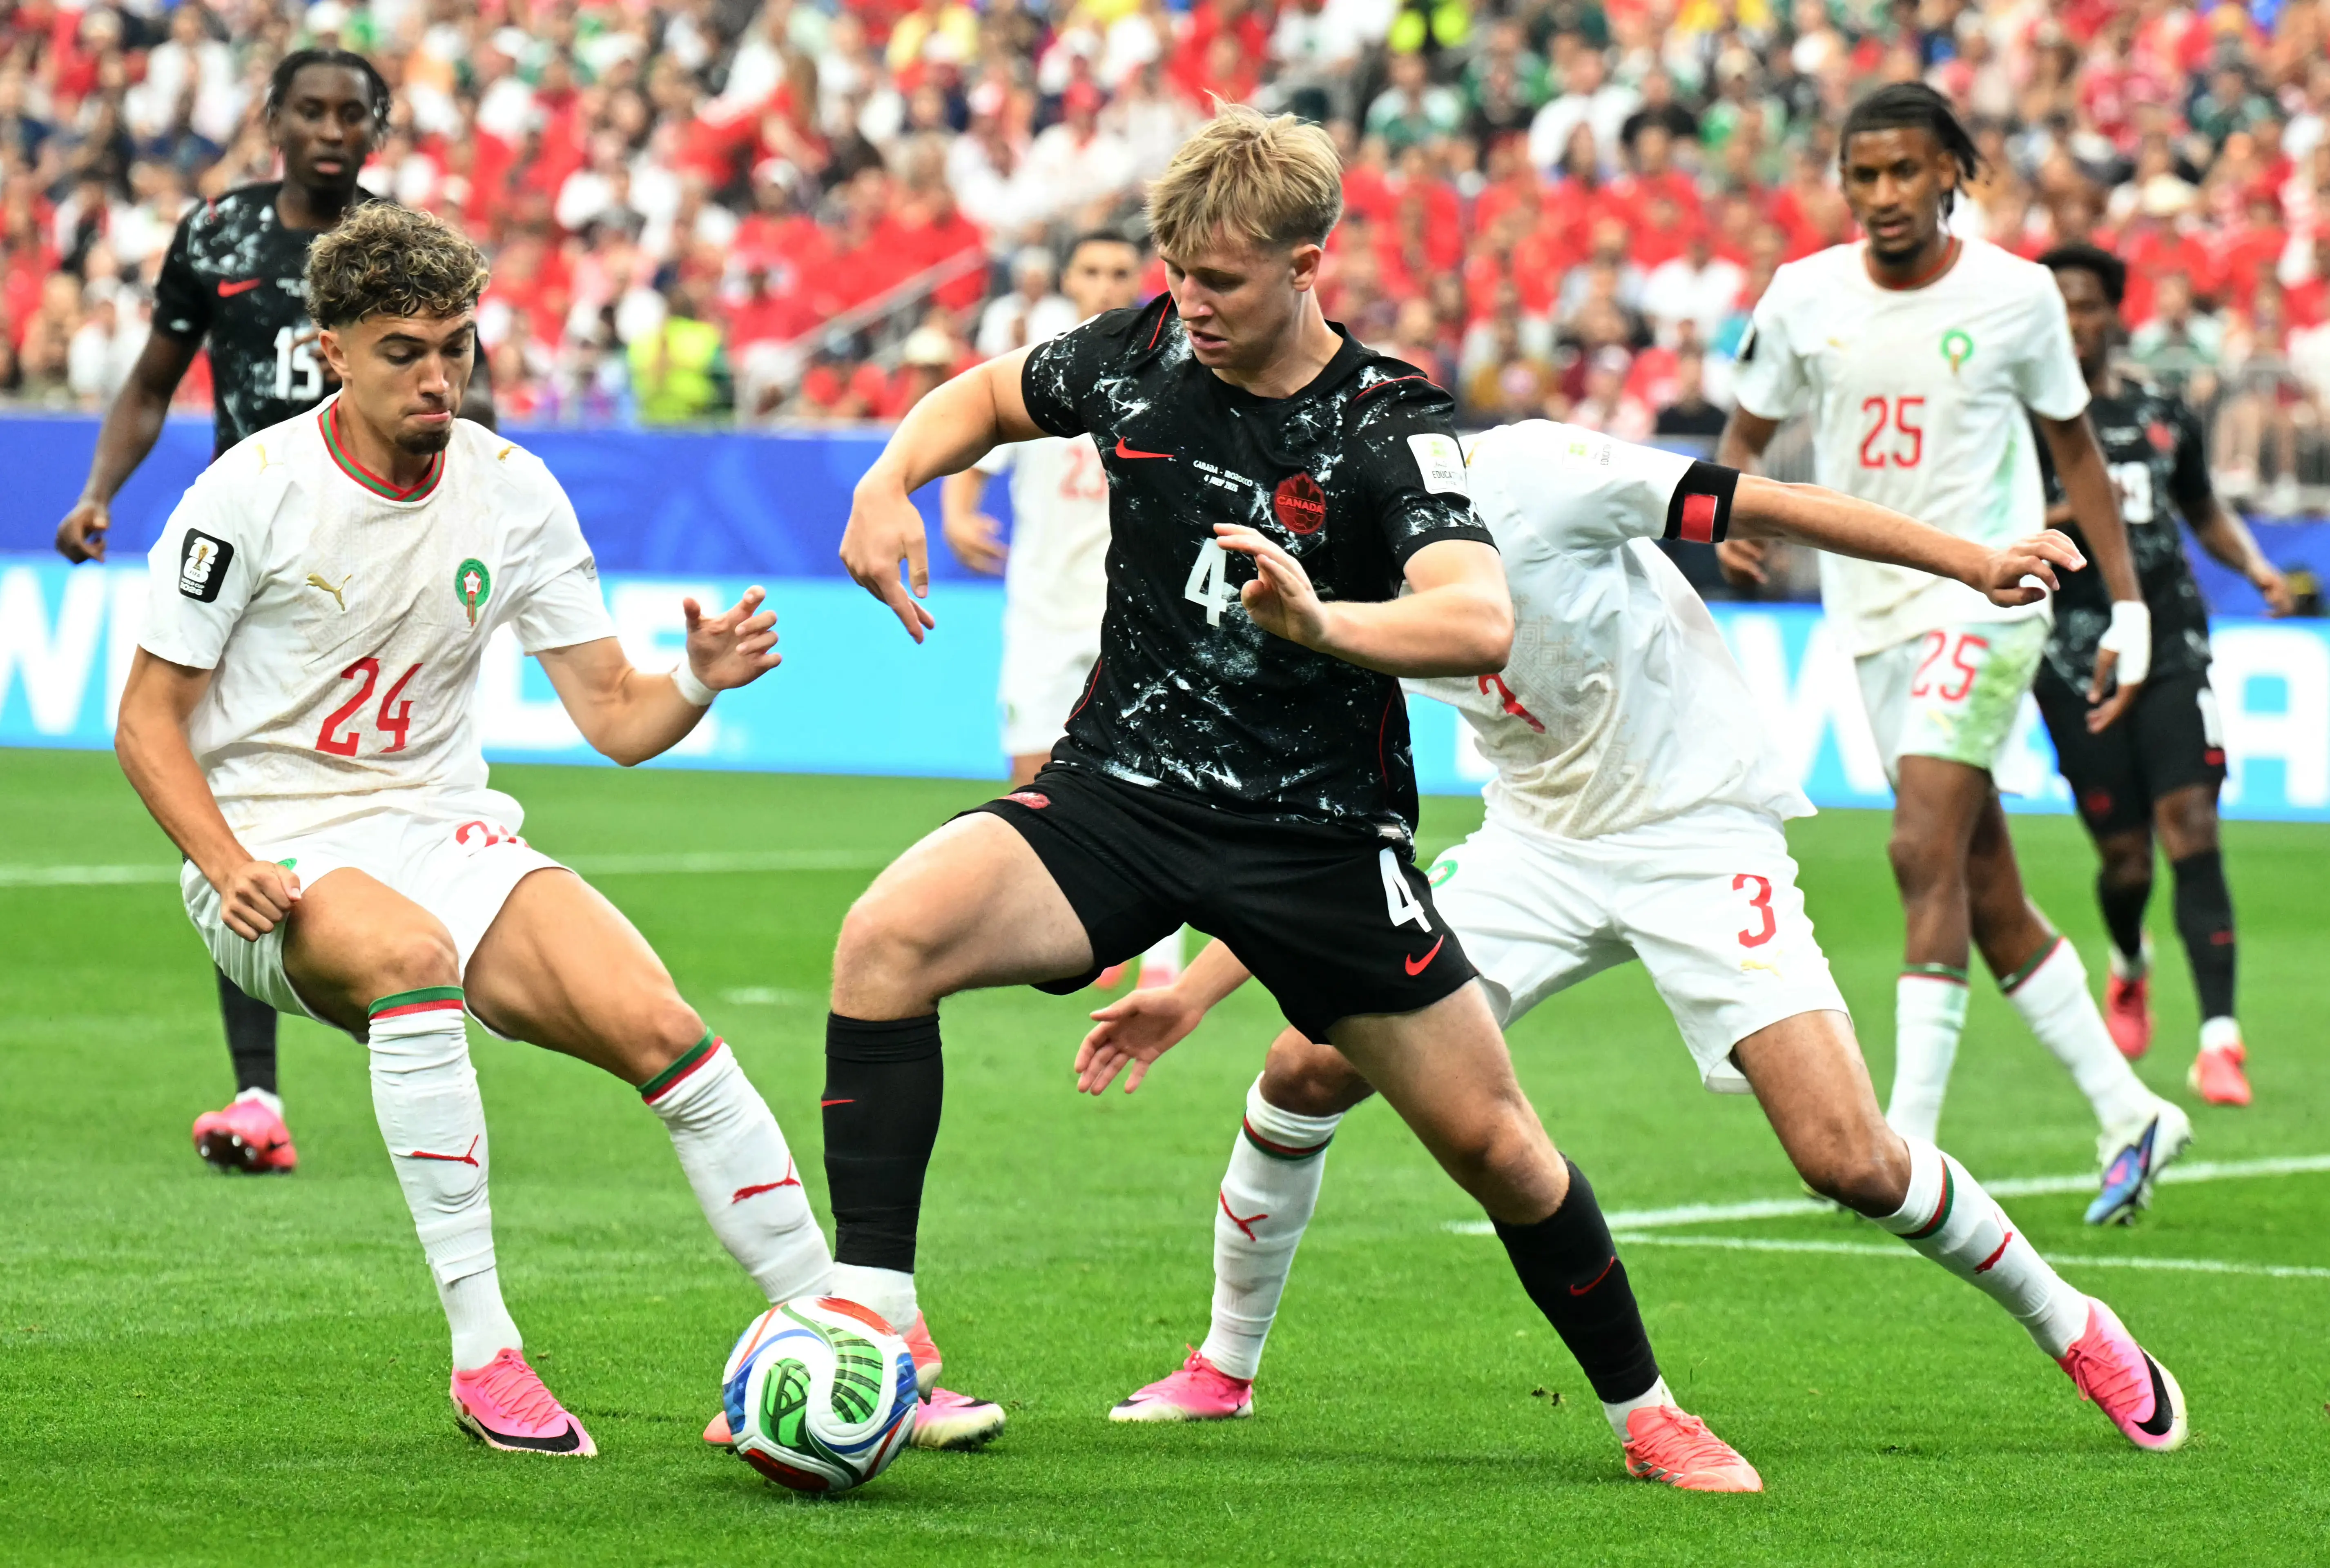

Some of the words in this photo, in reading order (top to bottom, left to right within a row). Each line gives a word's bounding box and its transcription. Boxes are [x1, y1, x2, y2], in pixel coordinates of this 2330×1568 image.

[274, 326, 323, 401] 15
[1860, 395, 1926, 469] 25
[1193, 460, 1218, 474] CANADA
[1224, 470, 1253, 487] MOROCCO
[1209, 476, 1225, 487] JULY
[1224, 481, 1239, 492] 2026
[1277, 496, 1324, 514] CANADA
[180, 582, 203, 595] 2026
[182, 577, 195, 586] WORLD
[1185, 537, 1227, 627] 4
[1911, 630, 1990, 703] 25
[315, 657, 424, 757] 24
[1379, 846, 1432, 933] 4
[1732, 874, 1776, 948] 3
